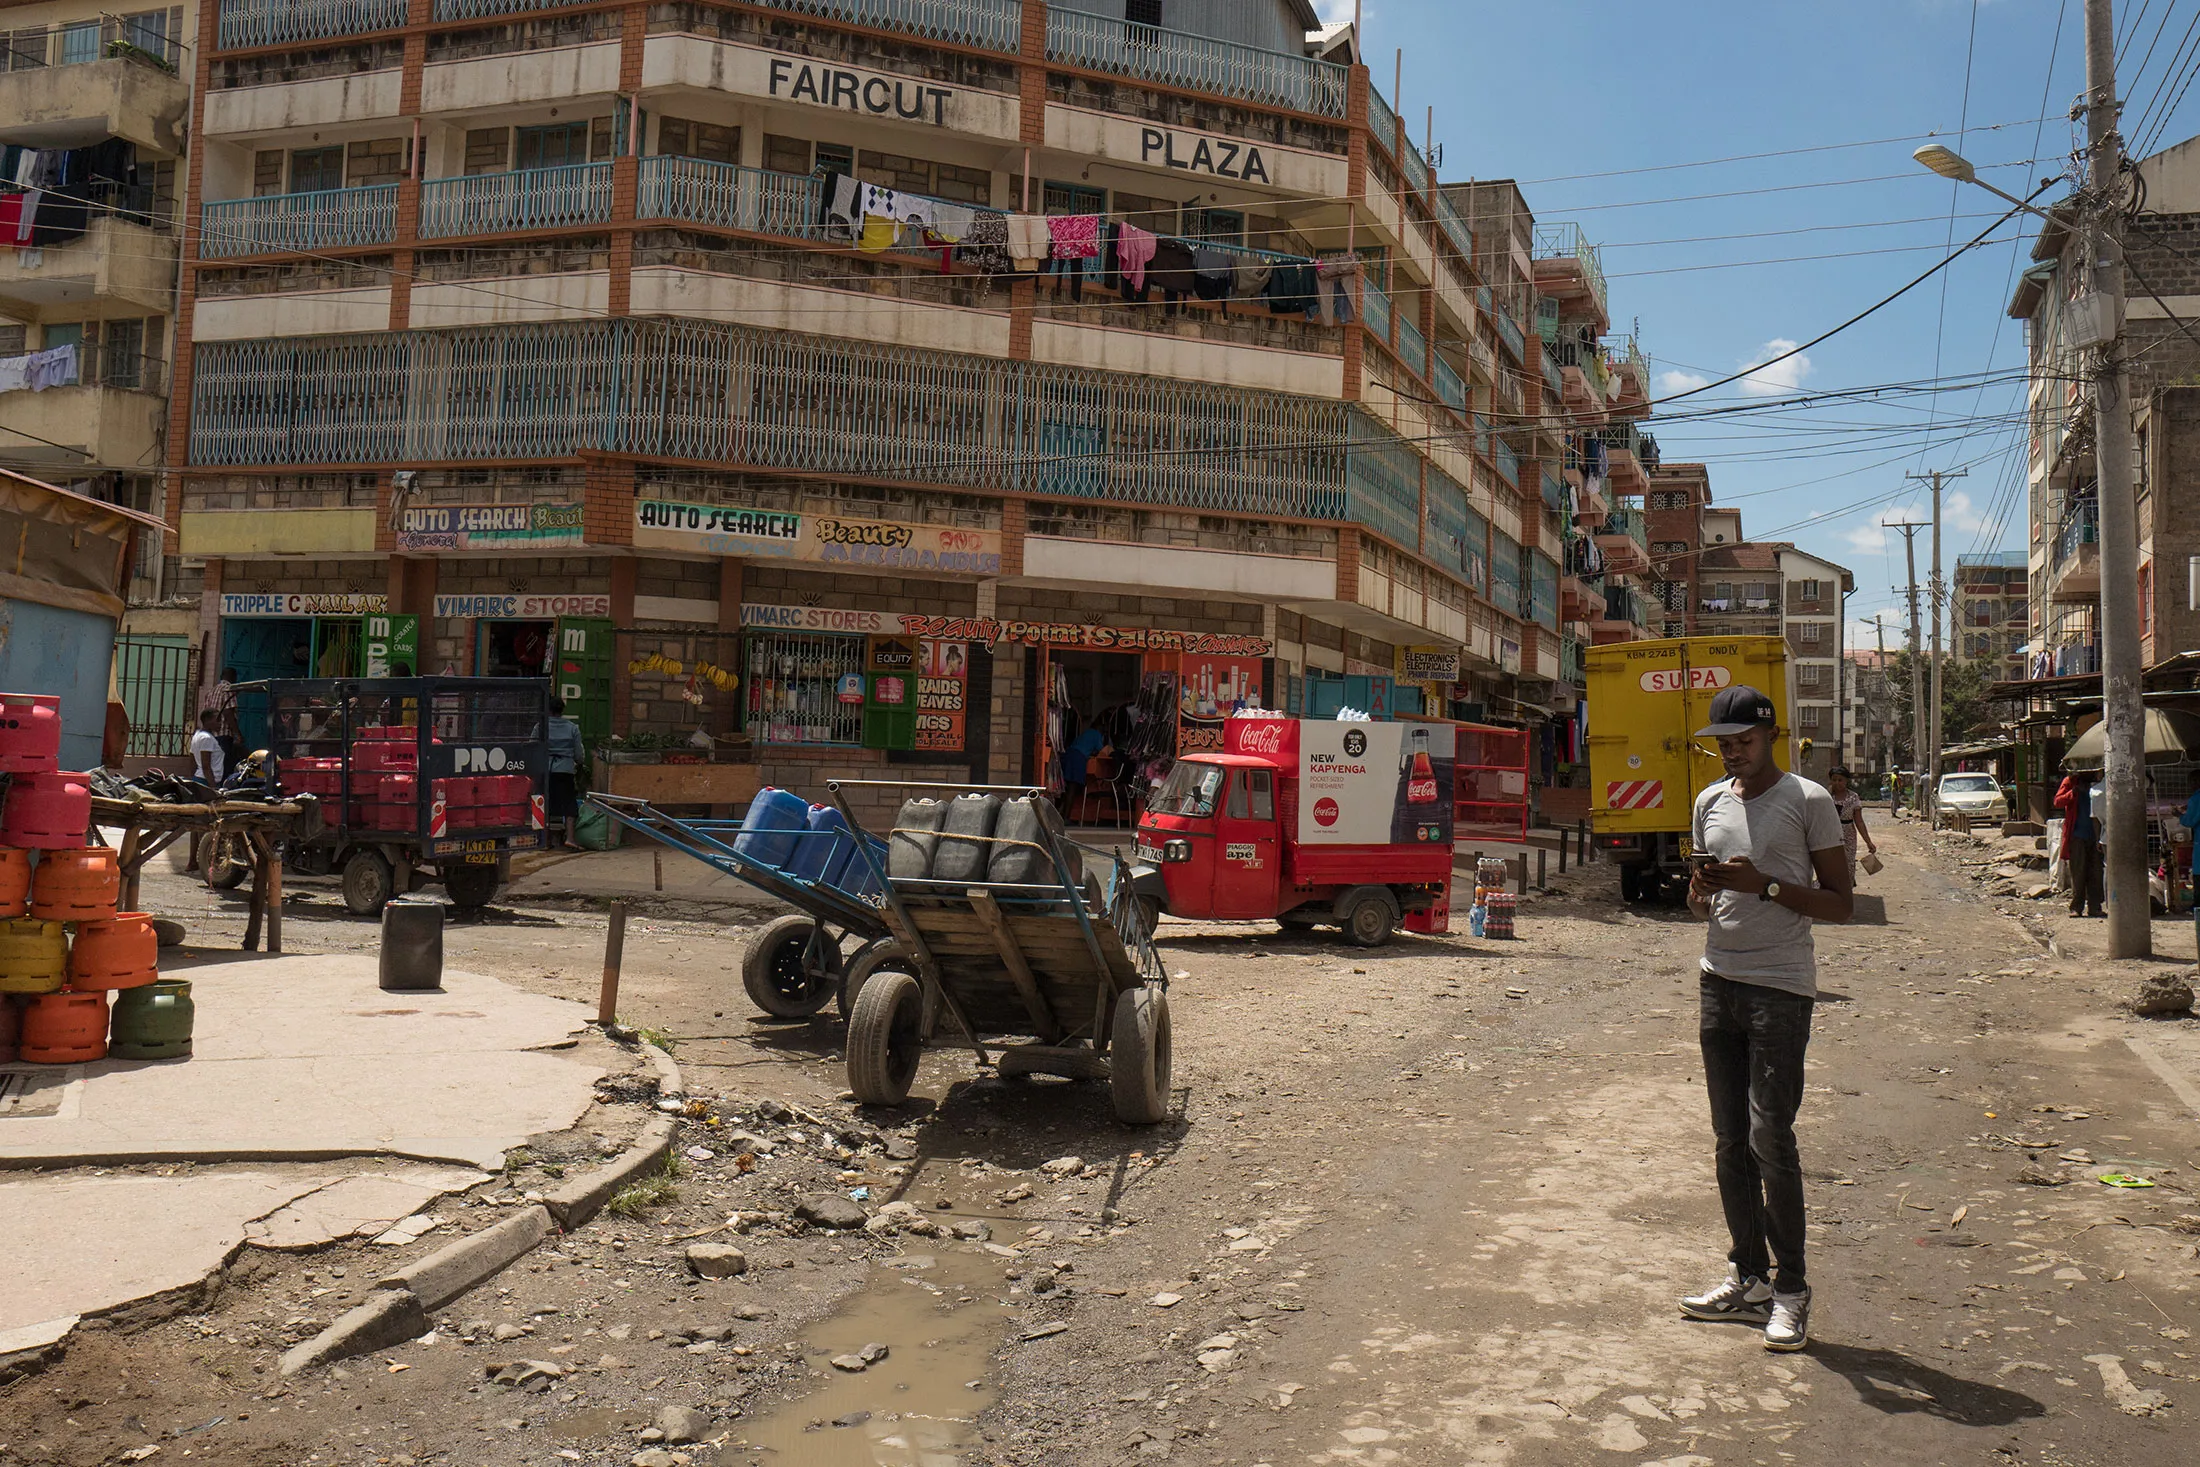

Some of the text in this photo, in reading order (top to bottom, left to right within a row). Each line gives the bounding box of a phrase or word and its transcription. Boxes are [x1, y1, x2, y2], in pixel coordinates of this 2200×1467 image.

[769, 59, 1270, 184] FAIRCUT PLAZA
[403, 507, 527, 532] AUTO SEARCH
[640, 502, 798, 539] AUTO SEARCH
[400, 531, 460, 552] General
[815, 518, 913, 549] Beauty
[820, 543, 1000, 574] MERCHANDISE
[224, 595, 283, 613] TRIPPLE
[288, 595, 300, 613] C
[304, 594, 354, 614] NAIL
[437, 597, 609, 616] VIMARC STORES
[739, 605, 882, 631] VIMARC STORES
[394, 617, 416, 643] SCRATCH
[898, 615, 1002, 653] Beauty
[1007, 621, 1082, 645] Point
[1089, 625, 1183, 650] Salon
[393, 643, 413, 653] CARDS
[1626, 651, 1646, 660] KBM
[1709, 646, 1728, 655] DND
[876, 653, 913, 664] EQUITY
[1406, 661, 1453, 672] ELECTRICALS
[1407, 670, 1457, 680] PHONE REPAIRS
[1652, 670, 1718, 690] SUPA
[918, 678, 961, 695] RAIDS
[0, 718, 19, 729] RO
[916, 731, 956, 739] ETAIL
[917, 738, 957, 746] OLESALE
[1240, 723, 1284, 754] Coca-Cola
[1348, 744, 1362, 753] 20
[454, 747, 525, 773] PRO GAS
[1310, 754, 1335, 763] NEW
[1310, 764, 1366, 774] KAPYENGA
[1408, 781, 1437, 797] Coca-Cola
[1226, 850, 1254, 859] apé
